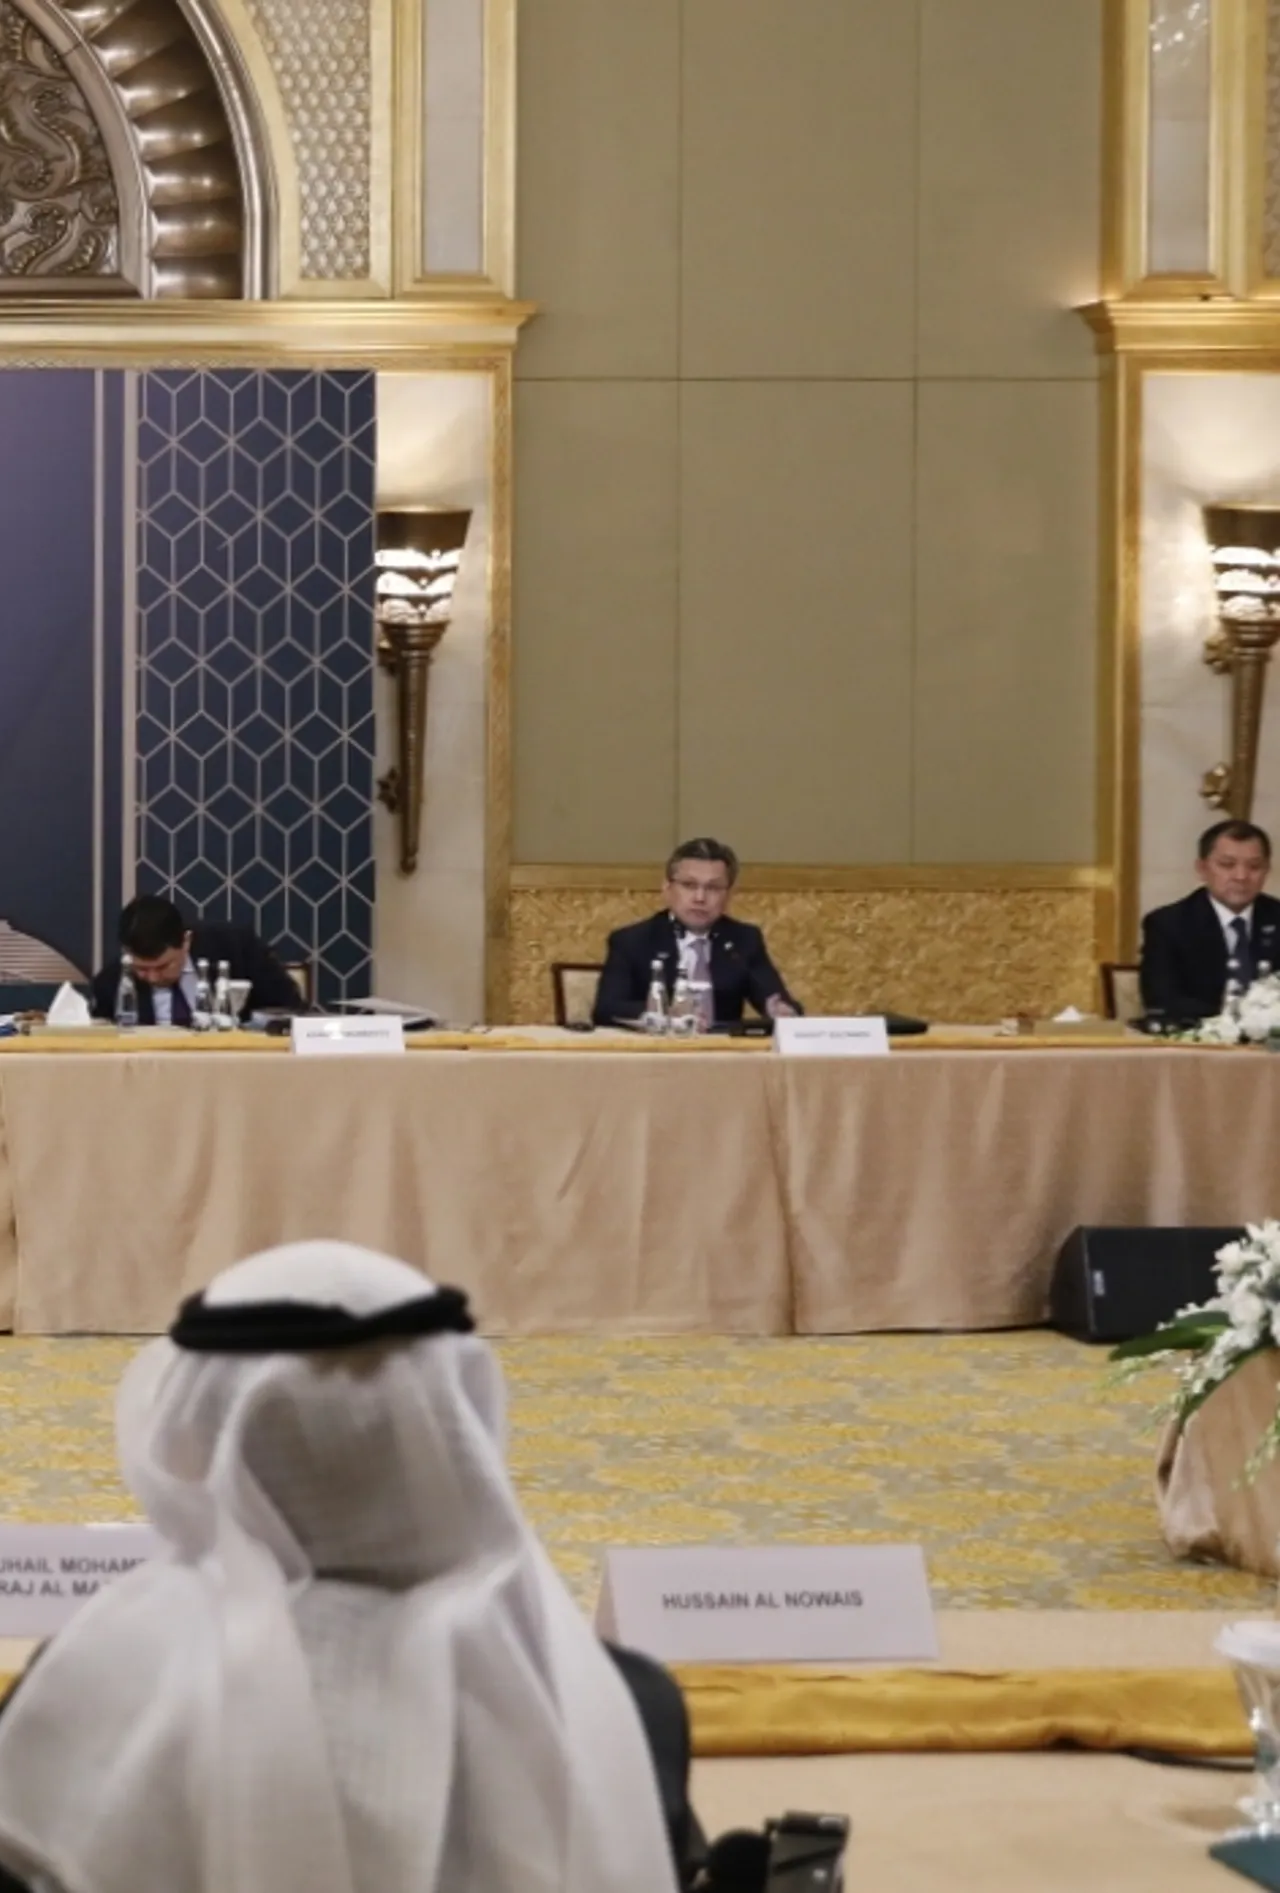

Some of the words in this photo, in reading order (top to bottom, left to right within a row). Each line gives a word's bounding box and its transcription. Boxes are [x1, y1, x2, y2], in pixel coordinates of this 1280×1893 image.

[40, 1580, 64, 1596] AL
[662, 1592, 749, 1609] HUSSAIN
[754, 1592, 780, 1608] AL
[785, 1589, 864, 1608] NOWAIS
